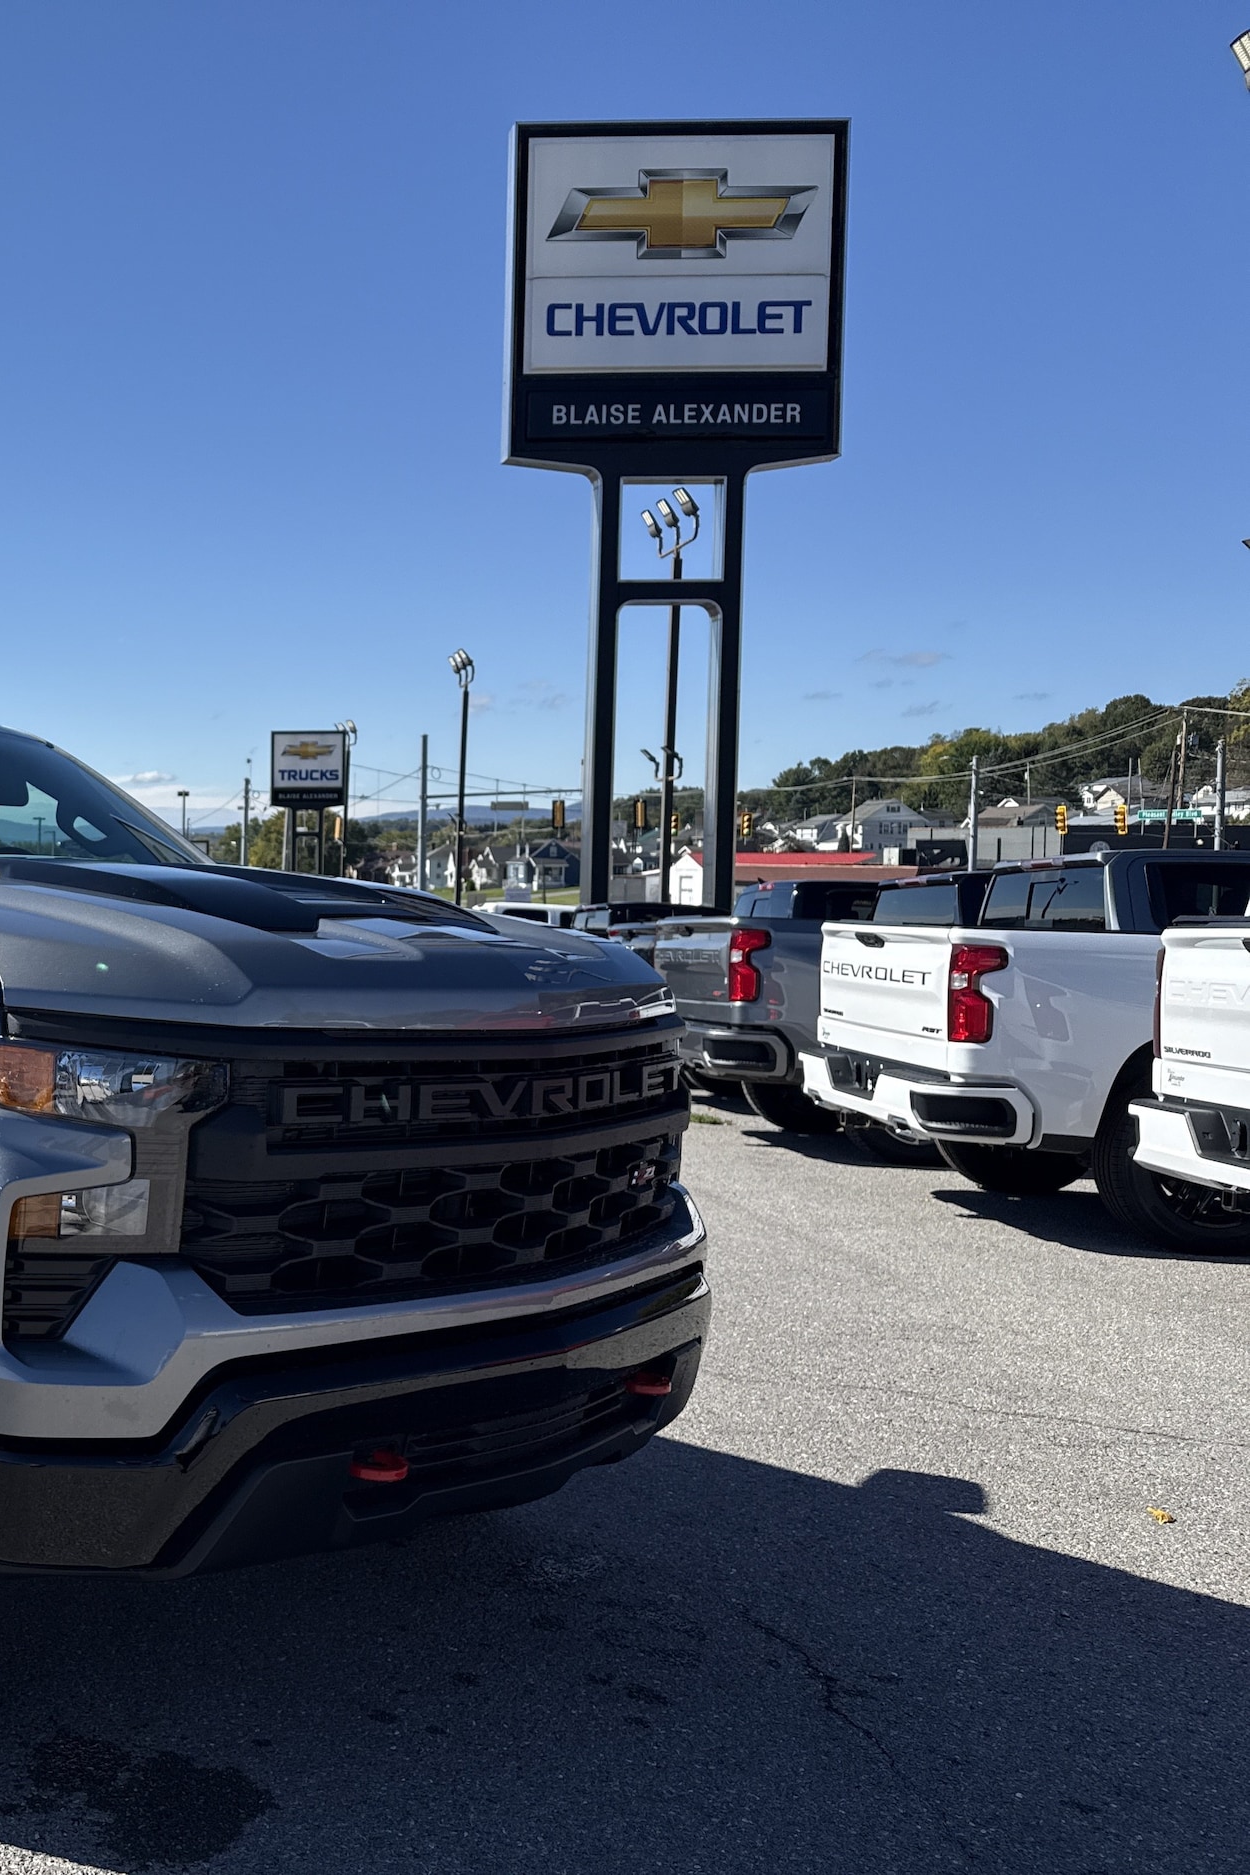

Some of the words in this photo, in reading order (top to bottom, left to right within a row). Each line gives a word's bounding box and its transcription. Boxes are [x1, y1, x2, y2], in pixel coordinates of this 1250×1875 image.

[546, 300, 813, 337] CHEVROLET
[552, 404, 642, 425] BLAISE
[651, 403, 802, 424] ALEXANDER
[278, 769, 339, 781] TRUCKS
[278, 792, 300, 800] BLAISE
[302, 792, 339, 800] ALEXANDER
[822, 960, 932, 986] CHEVROLET
[1163, 1045, 1212, 1059] SILVERADO
[280, 1059, 682, 1124] CHEVROLET
